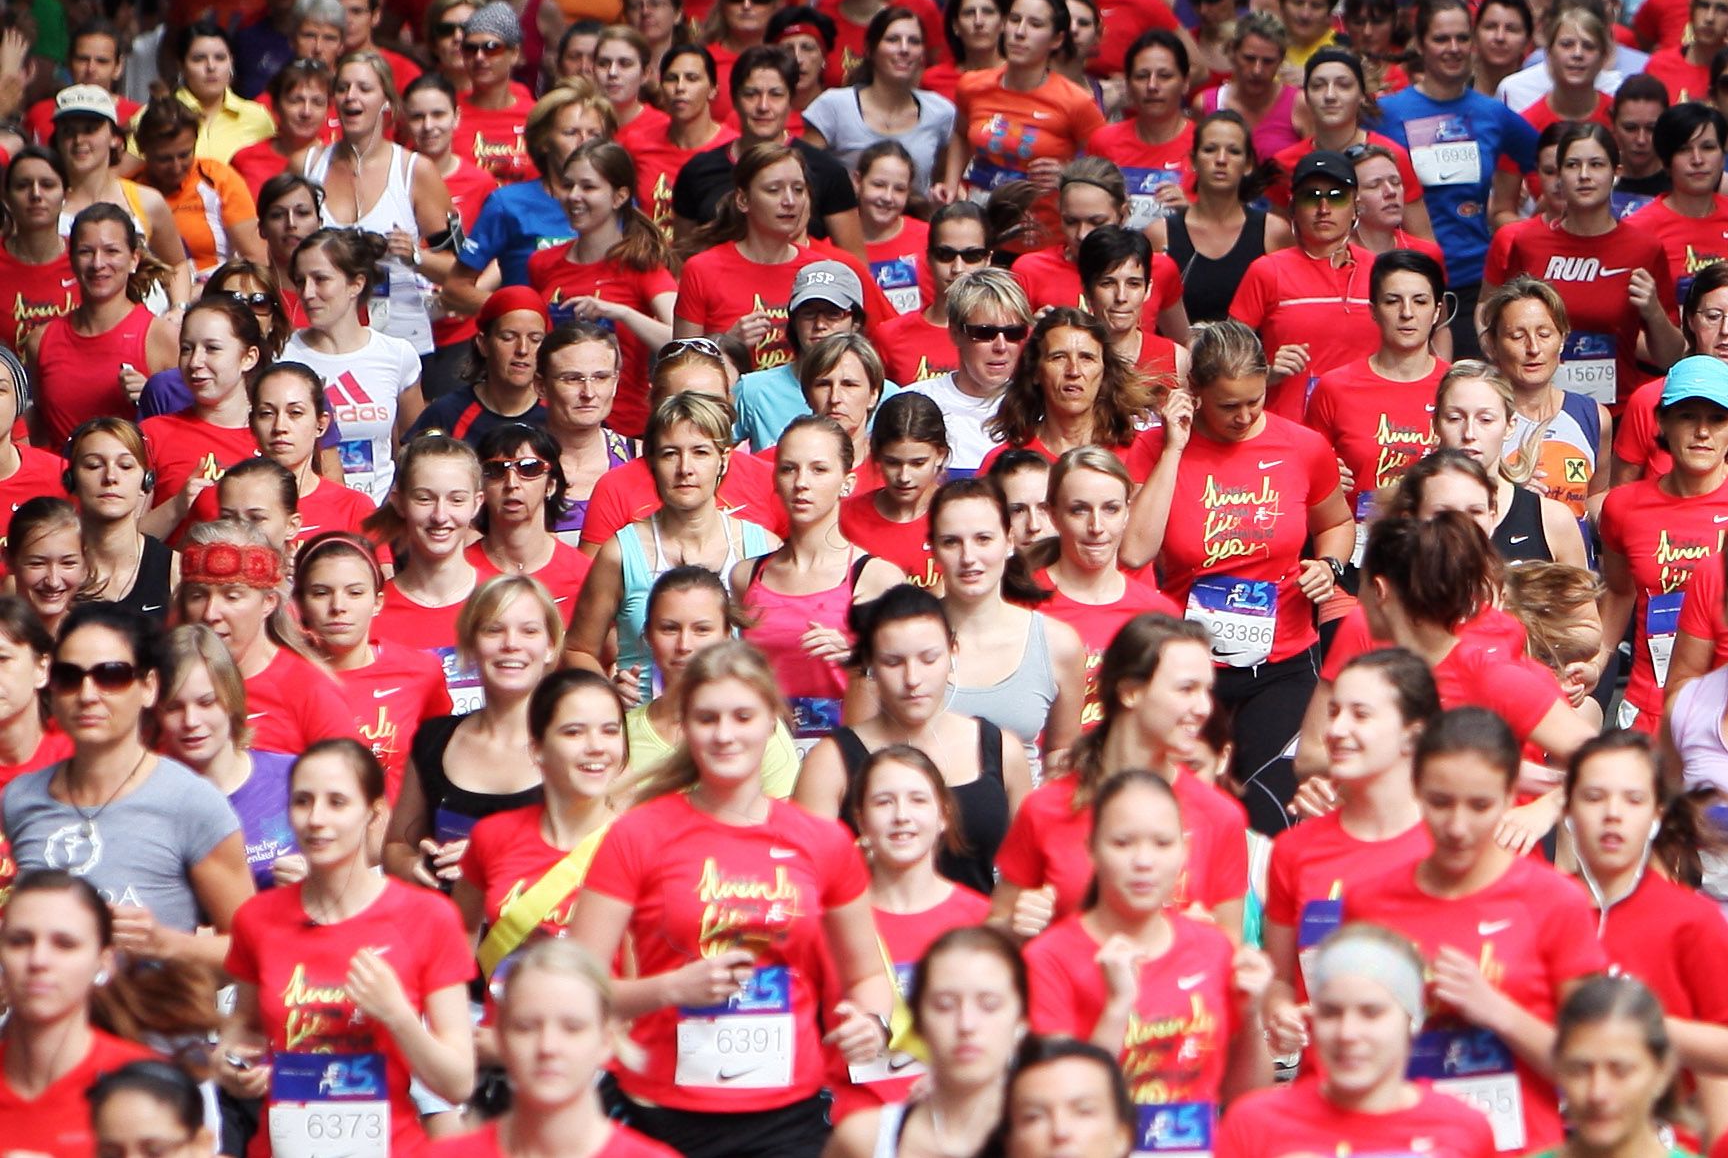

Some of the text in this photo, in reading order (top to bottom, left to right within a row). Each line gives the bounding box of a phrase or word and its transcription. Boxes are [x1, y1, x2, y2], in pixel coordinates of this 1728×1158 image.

[1544, 255, 1601, 283] RUN
[1566, 366, 1614, 382] 15679
[339, 405, 389, 423] das
[1212, 619, 1273, 645] 23386
[716, 1025, 783, 1056] 6391
[306, 1113, 383, 1140] 6373
